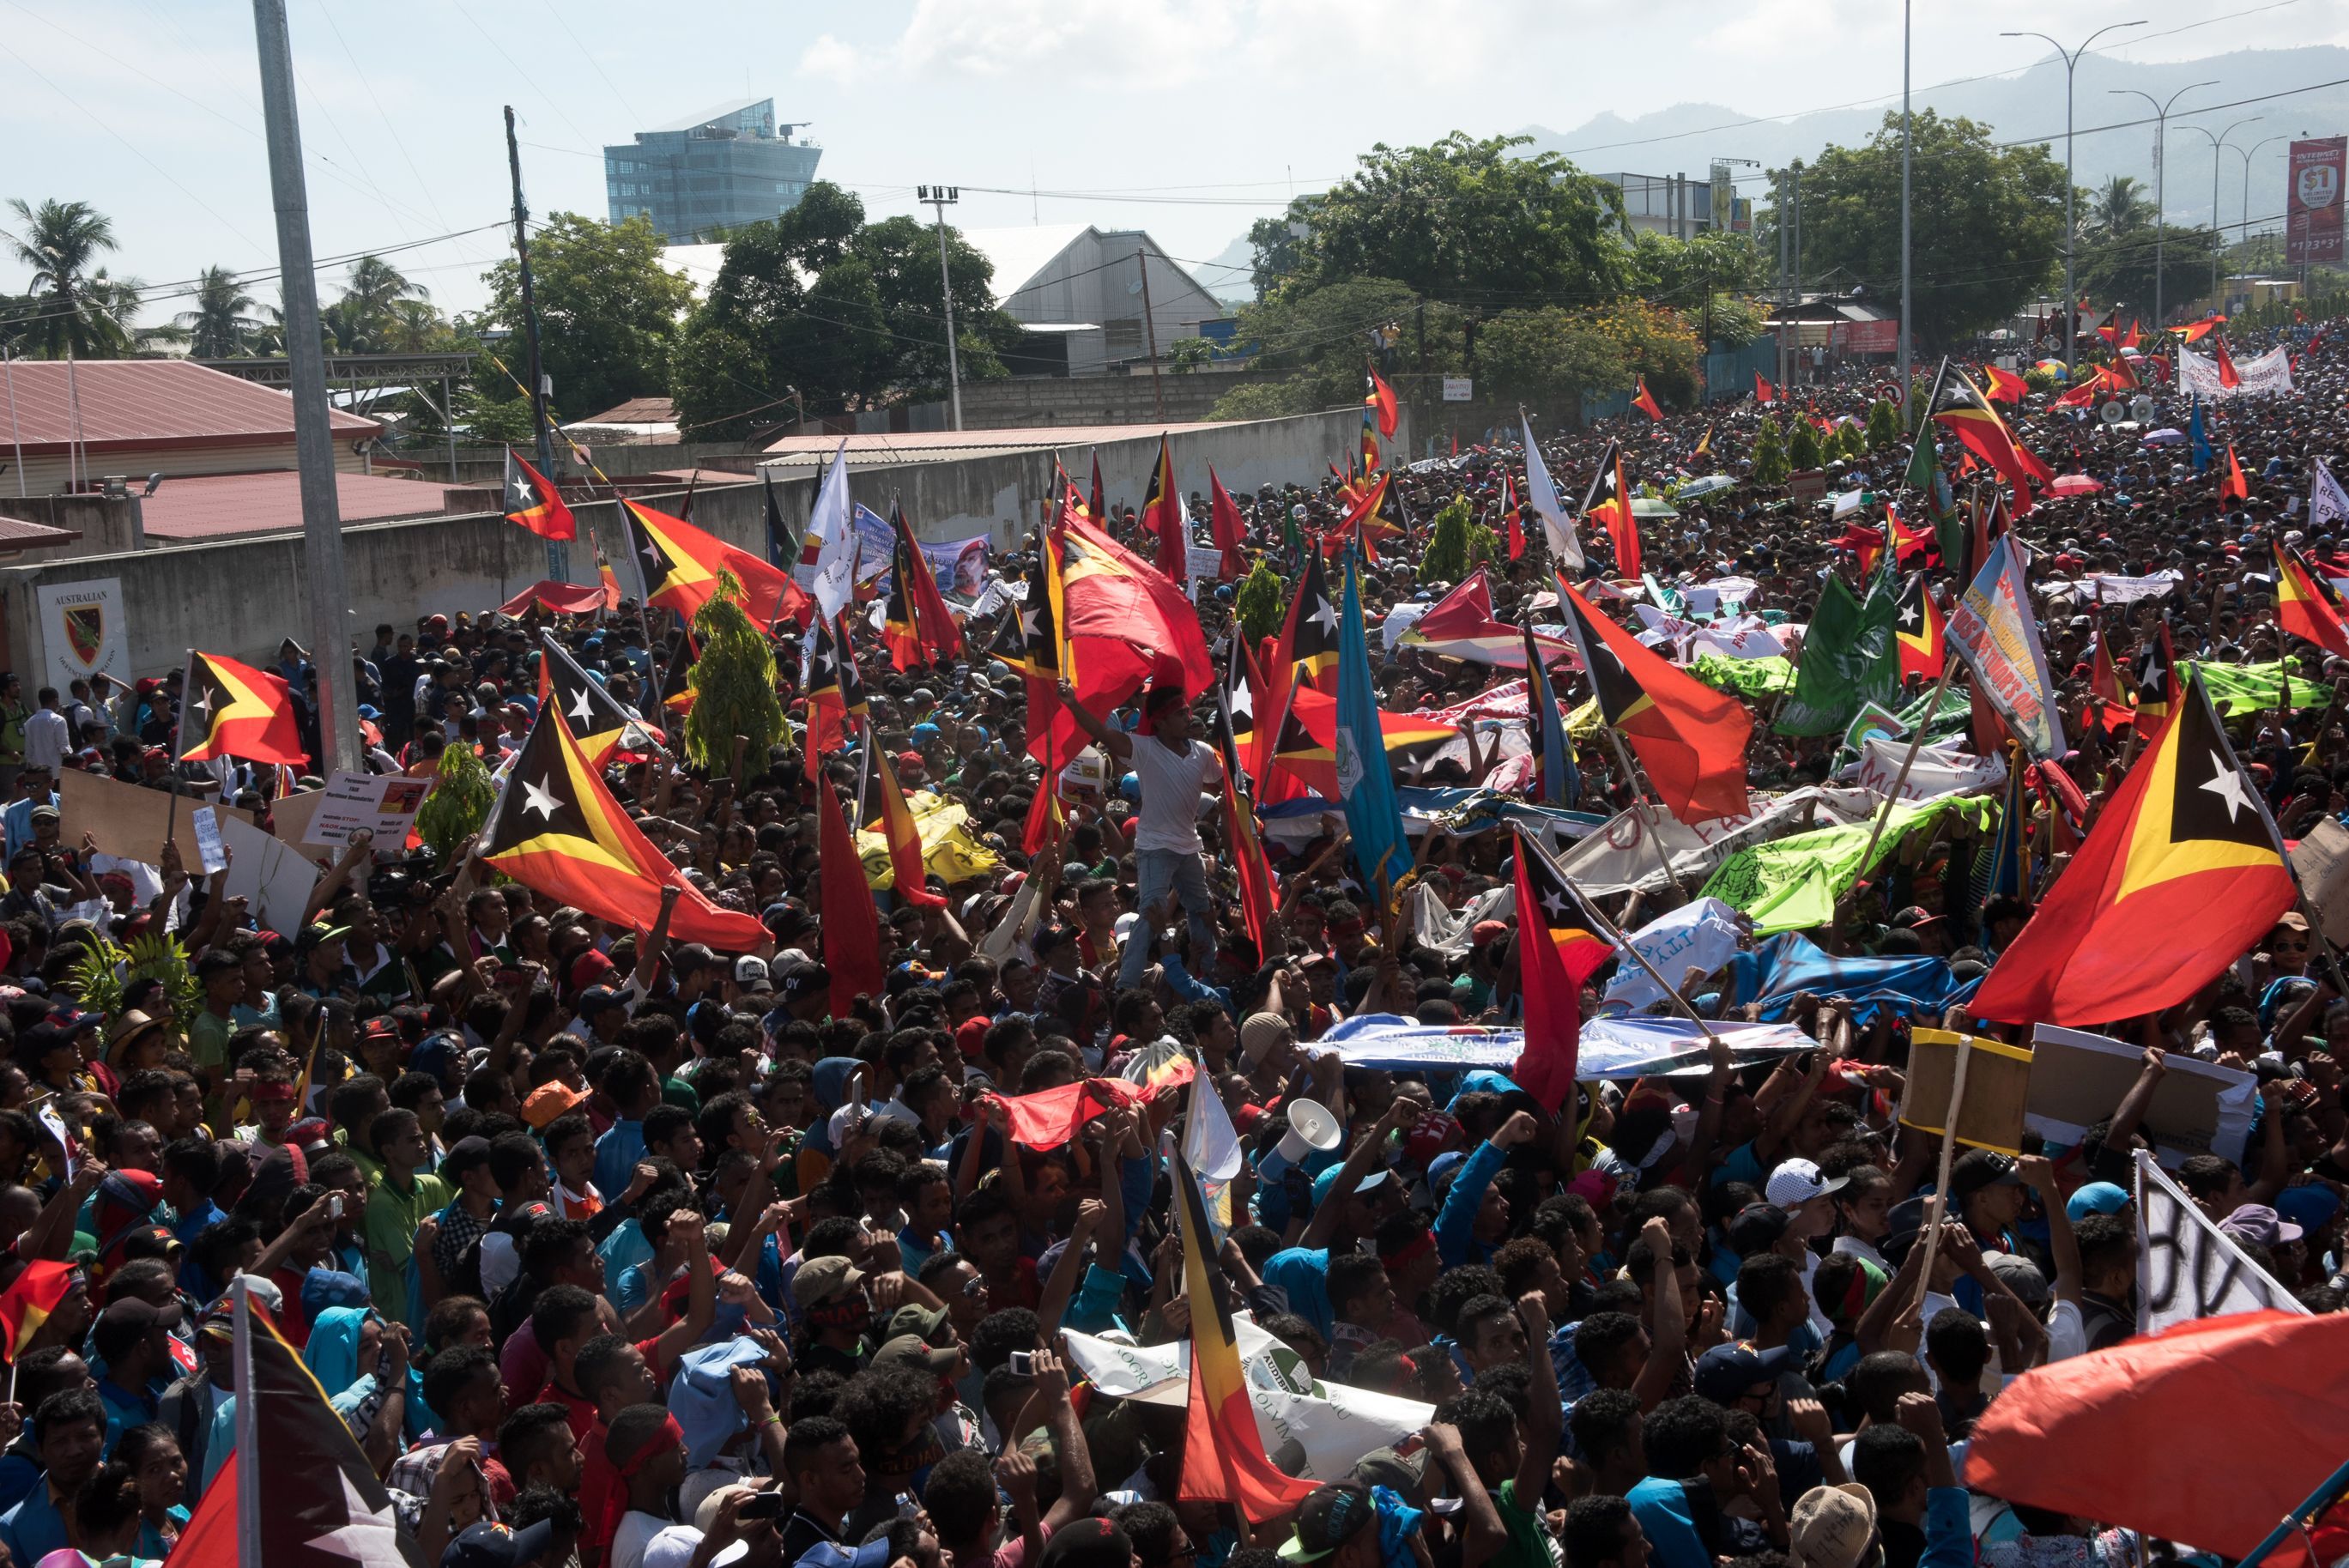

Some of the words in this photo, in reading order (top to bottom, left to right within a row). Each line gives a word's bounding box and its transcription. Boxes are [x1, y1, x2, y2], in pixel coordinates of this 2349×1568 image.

[2304, 167, 2329, 191] $1
[55, 590, 107, 605] AUSTRALIAN
[1984, 649, 2021, 701] TIMOR'S
[348, 795, 375, 803] Boundaries
